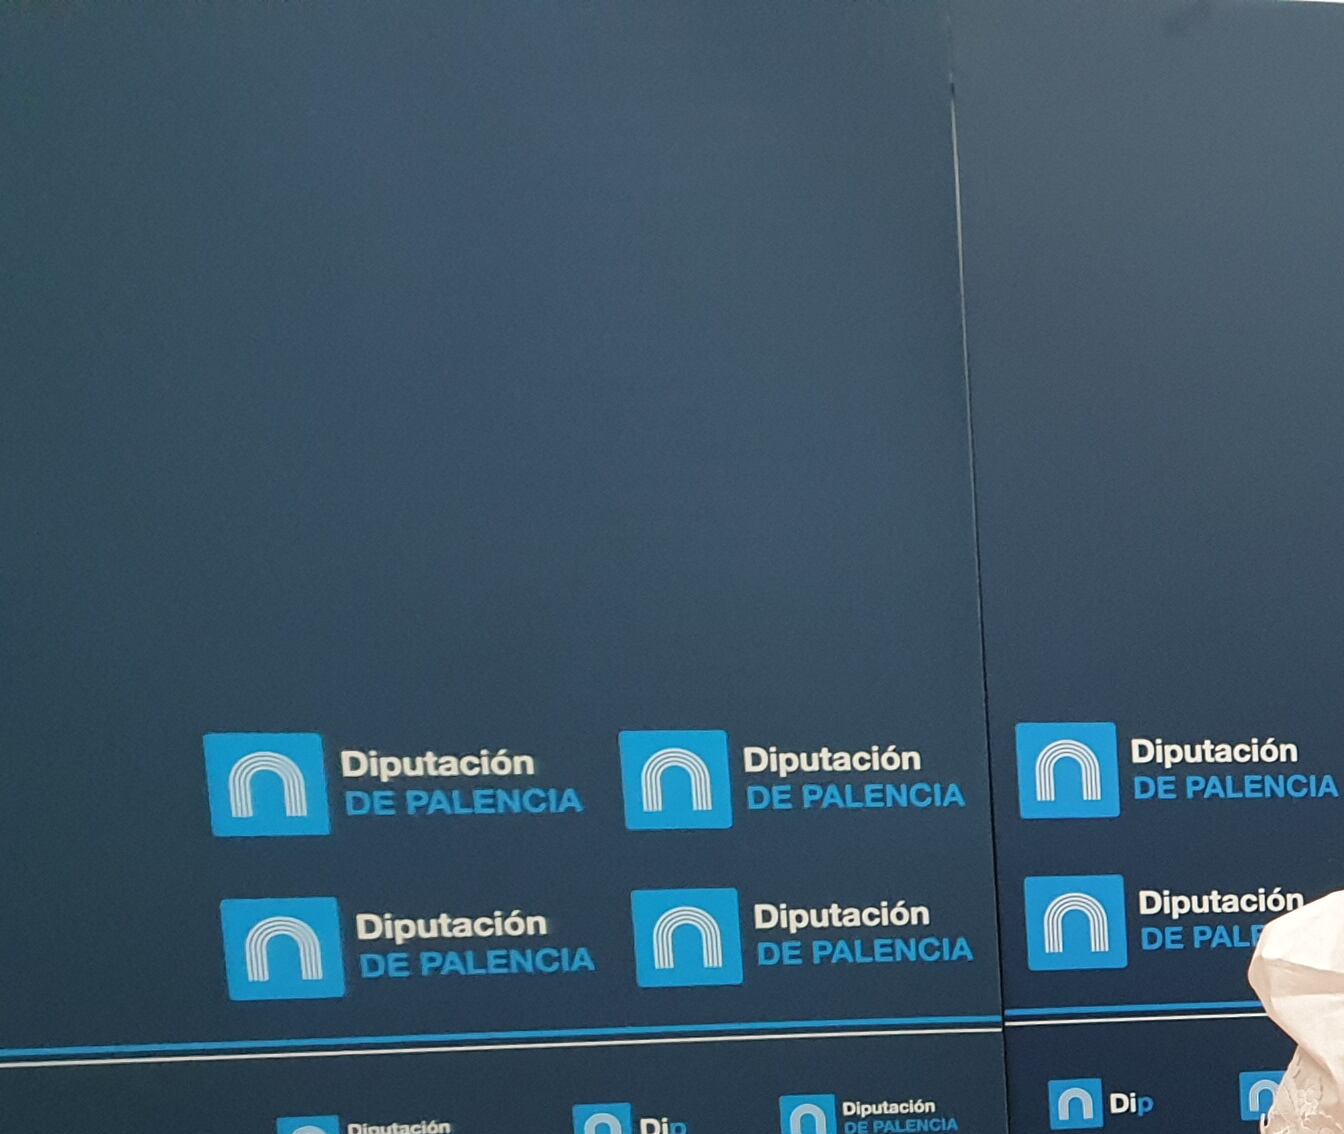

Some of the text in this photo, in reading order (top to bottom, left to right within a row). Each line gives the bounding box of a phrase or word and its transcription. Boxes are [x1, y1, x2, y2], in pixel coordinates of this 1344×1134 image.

[340, 750, 534, 782] Diputación
[743, 745, 921, 775] Diputación
[1131, 738, 1298, 769] Diputación
[345, 787, 584, 816] DE PALENCIA
[746, 782, 966, 810] DE PALENCIA
[1134, 774, 1339, 800] DE PALENCIA
[754, 902, 929, 933] Diputación
[1139, 887, 1304, 919] Diputación
[356, 911, 547, 946] Diputación
[1141, 926, 1184, 950] DE
[360, 948, 595, 978] DE PALENCIA
[757, 937, 974, 966] DE PALENCIA
[842, 1098, 936, 1117] Diputación
[1110, 1093, 1154, 1116] Dip
[844, 1116, 959, 1134] DE PALENCIA
